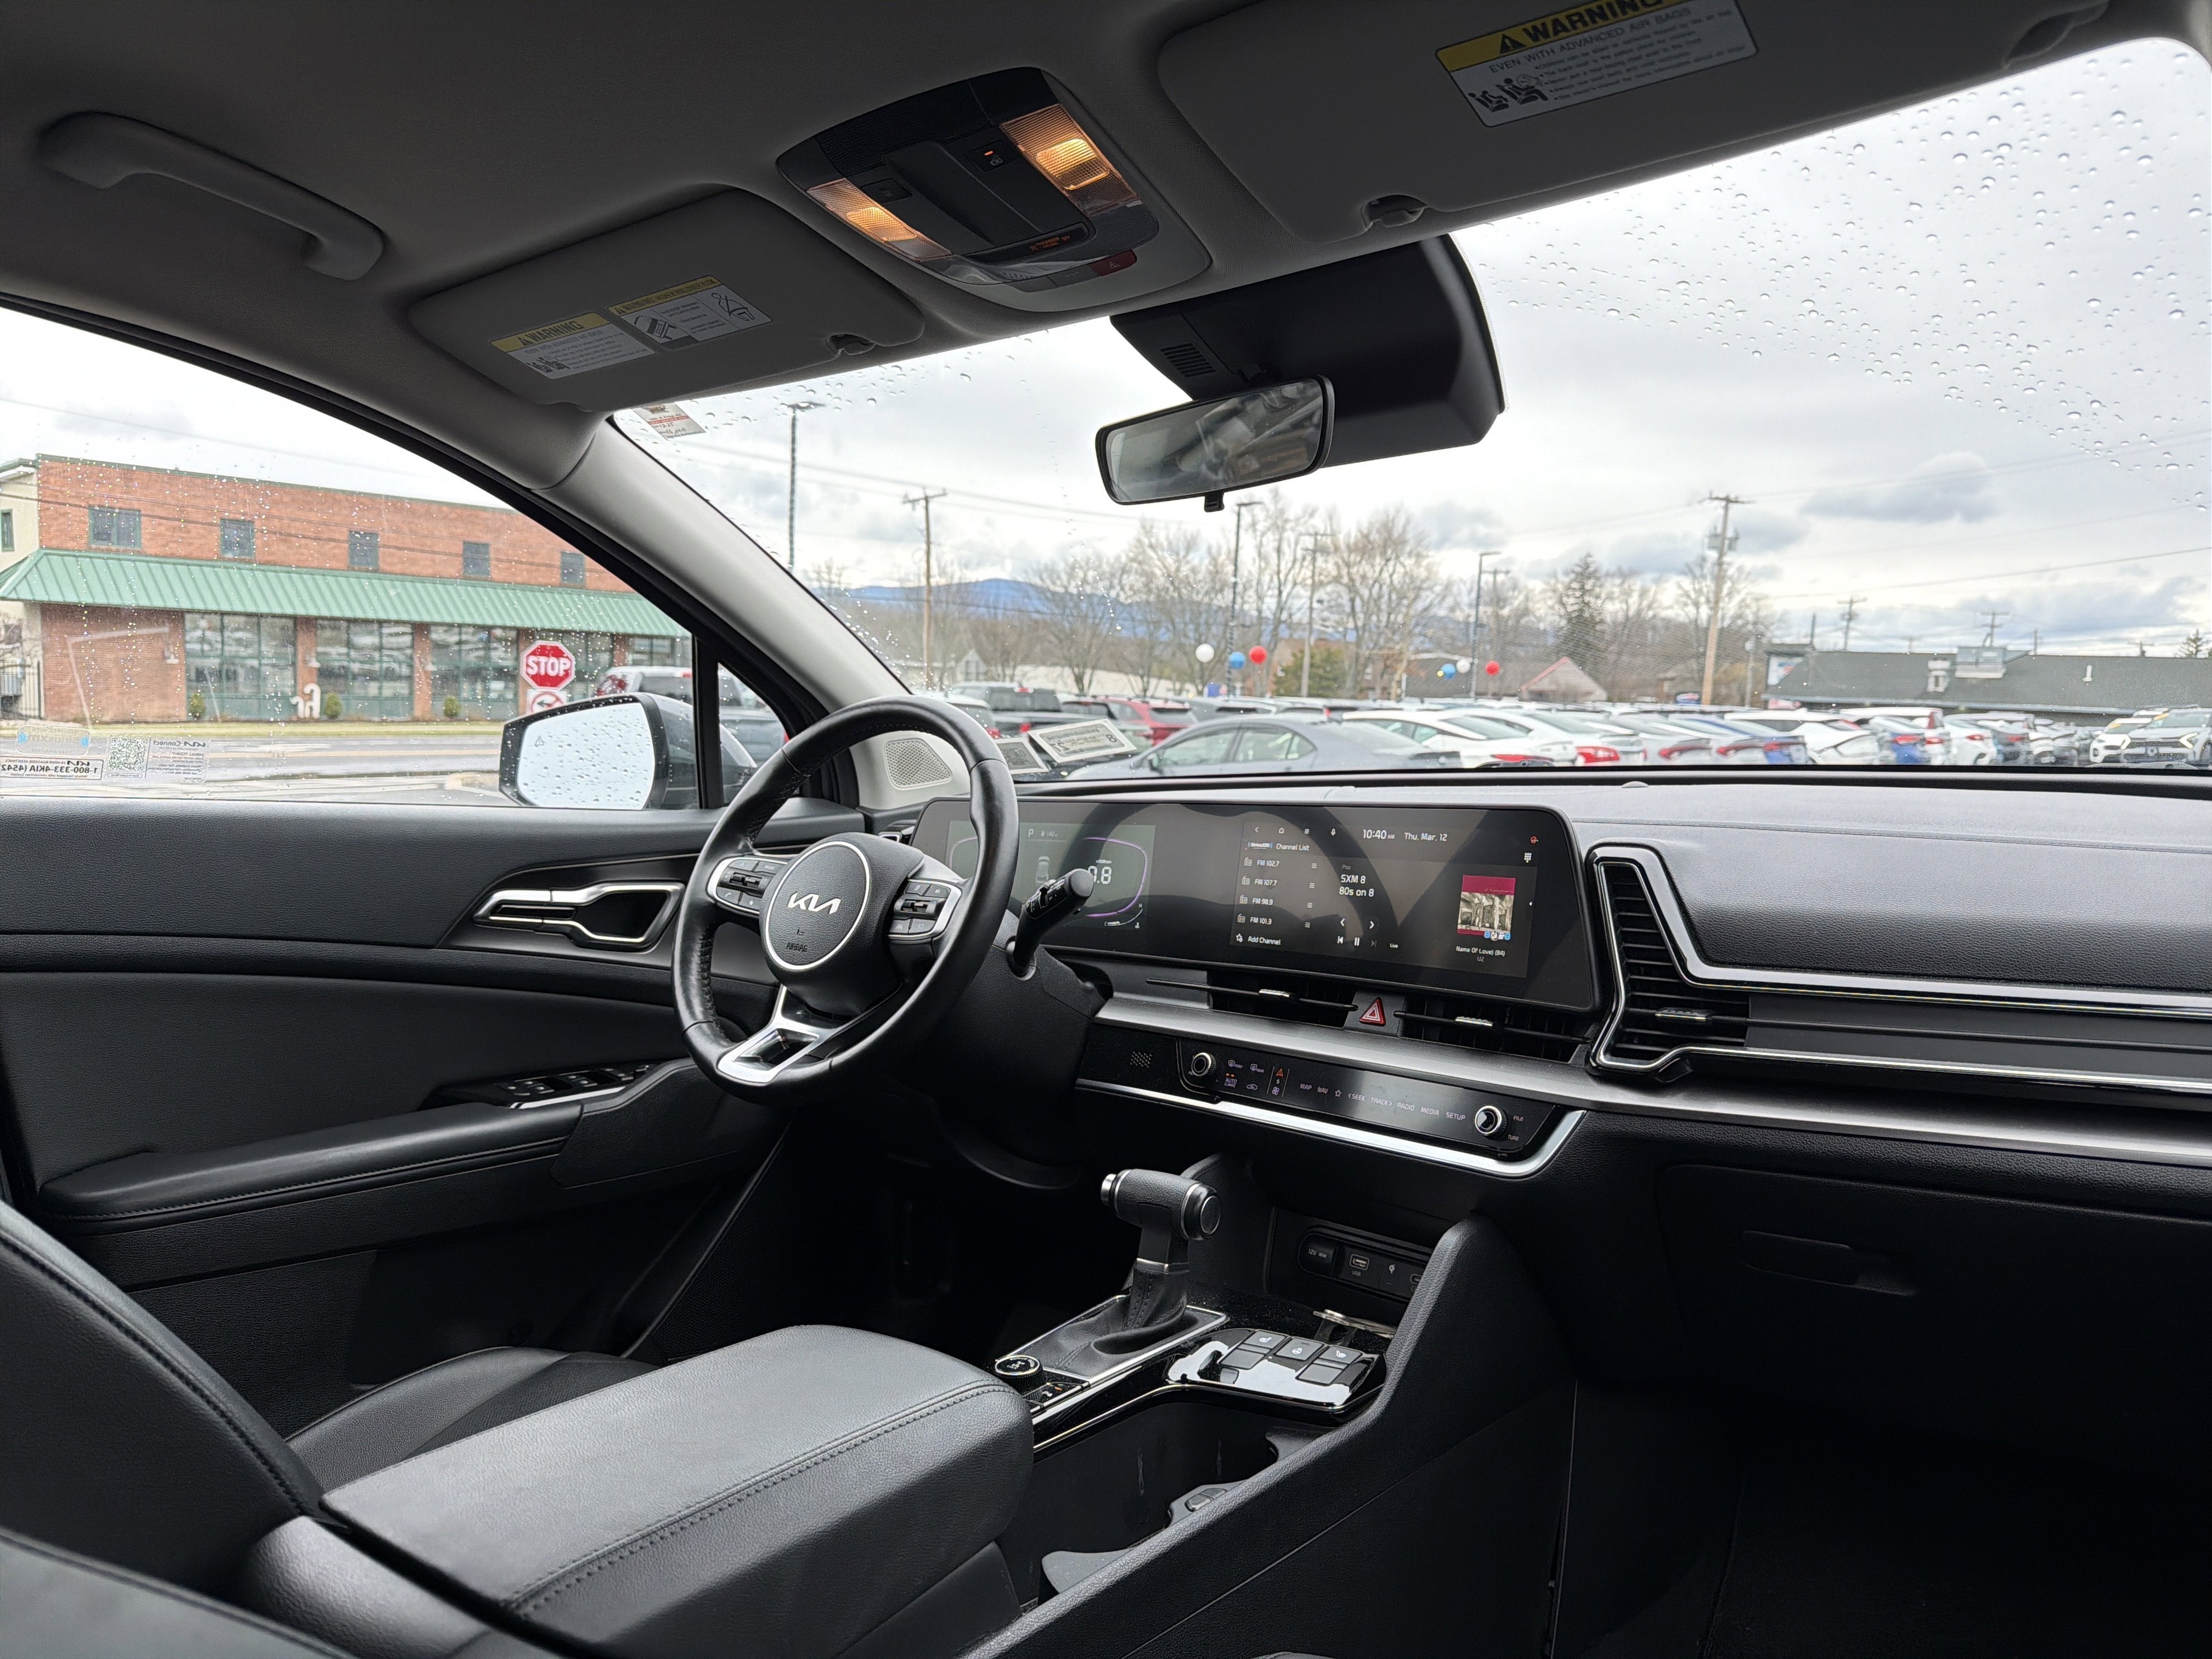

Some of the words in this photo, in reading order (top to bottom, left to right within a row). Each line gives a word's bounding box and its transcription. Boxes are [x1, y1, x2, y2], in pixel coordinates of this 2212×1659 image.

[1488, 58, 1521, 73] EVEN
[1525, 48, 1555, 63] WITH
[1559, 27, 1624, 53] ADVANCED
[1629, 19, 1650, 32] AIR
[1654, 7, 1691, 25] BAGS
[528, 320, 585, 343] WARNING
[526, 656, 571, 677] STOP
[1028, 828, 1034, 838] P
[1363, 830, 1386, 839] 10:40
[1404, 832, 1419, 841] Thu,
[1440, 833, 1448, 842] 12
[1341, 874, 1358, 883] SXM
[1360, 876, 1366, 884] 8
[1339, 887, 1354, 896] 80s
[1368, 889, 1374, 897] 8
[787, 891, 841, 916] KIA
[1259, 937, 1281, 945] Channel
[1351, 1093, 1365, 1102] SEEK
[1371, 1097, 1389, 1106] TRACK
[1397, 1102, 1415, 1111] RADIO
[1420, 1107, 1440, 1116] MEDIA
[1446, 1111, 1466, 1121] SETUP
